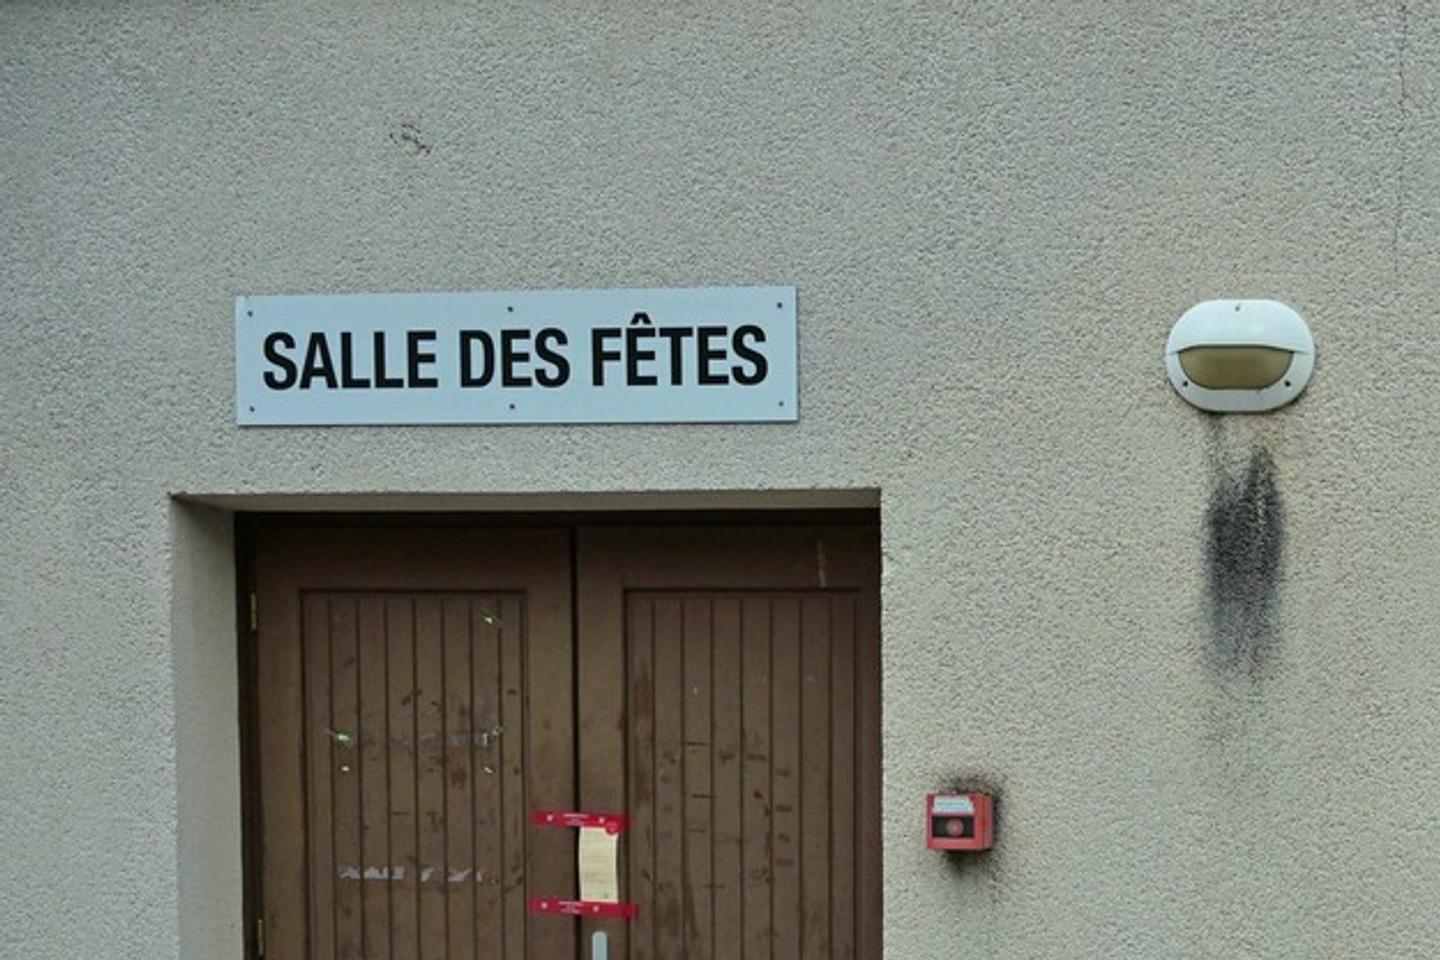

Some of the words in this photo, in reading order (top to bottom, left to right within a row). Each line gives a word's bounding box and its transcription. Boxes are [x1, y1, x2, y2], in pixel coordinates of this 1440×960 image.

[262, 330, 439, 390] SALLE
[459, 327, 570, 388] DES
[591, 311, 768, 386] FÊTES
